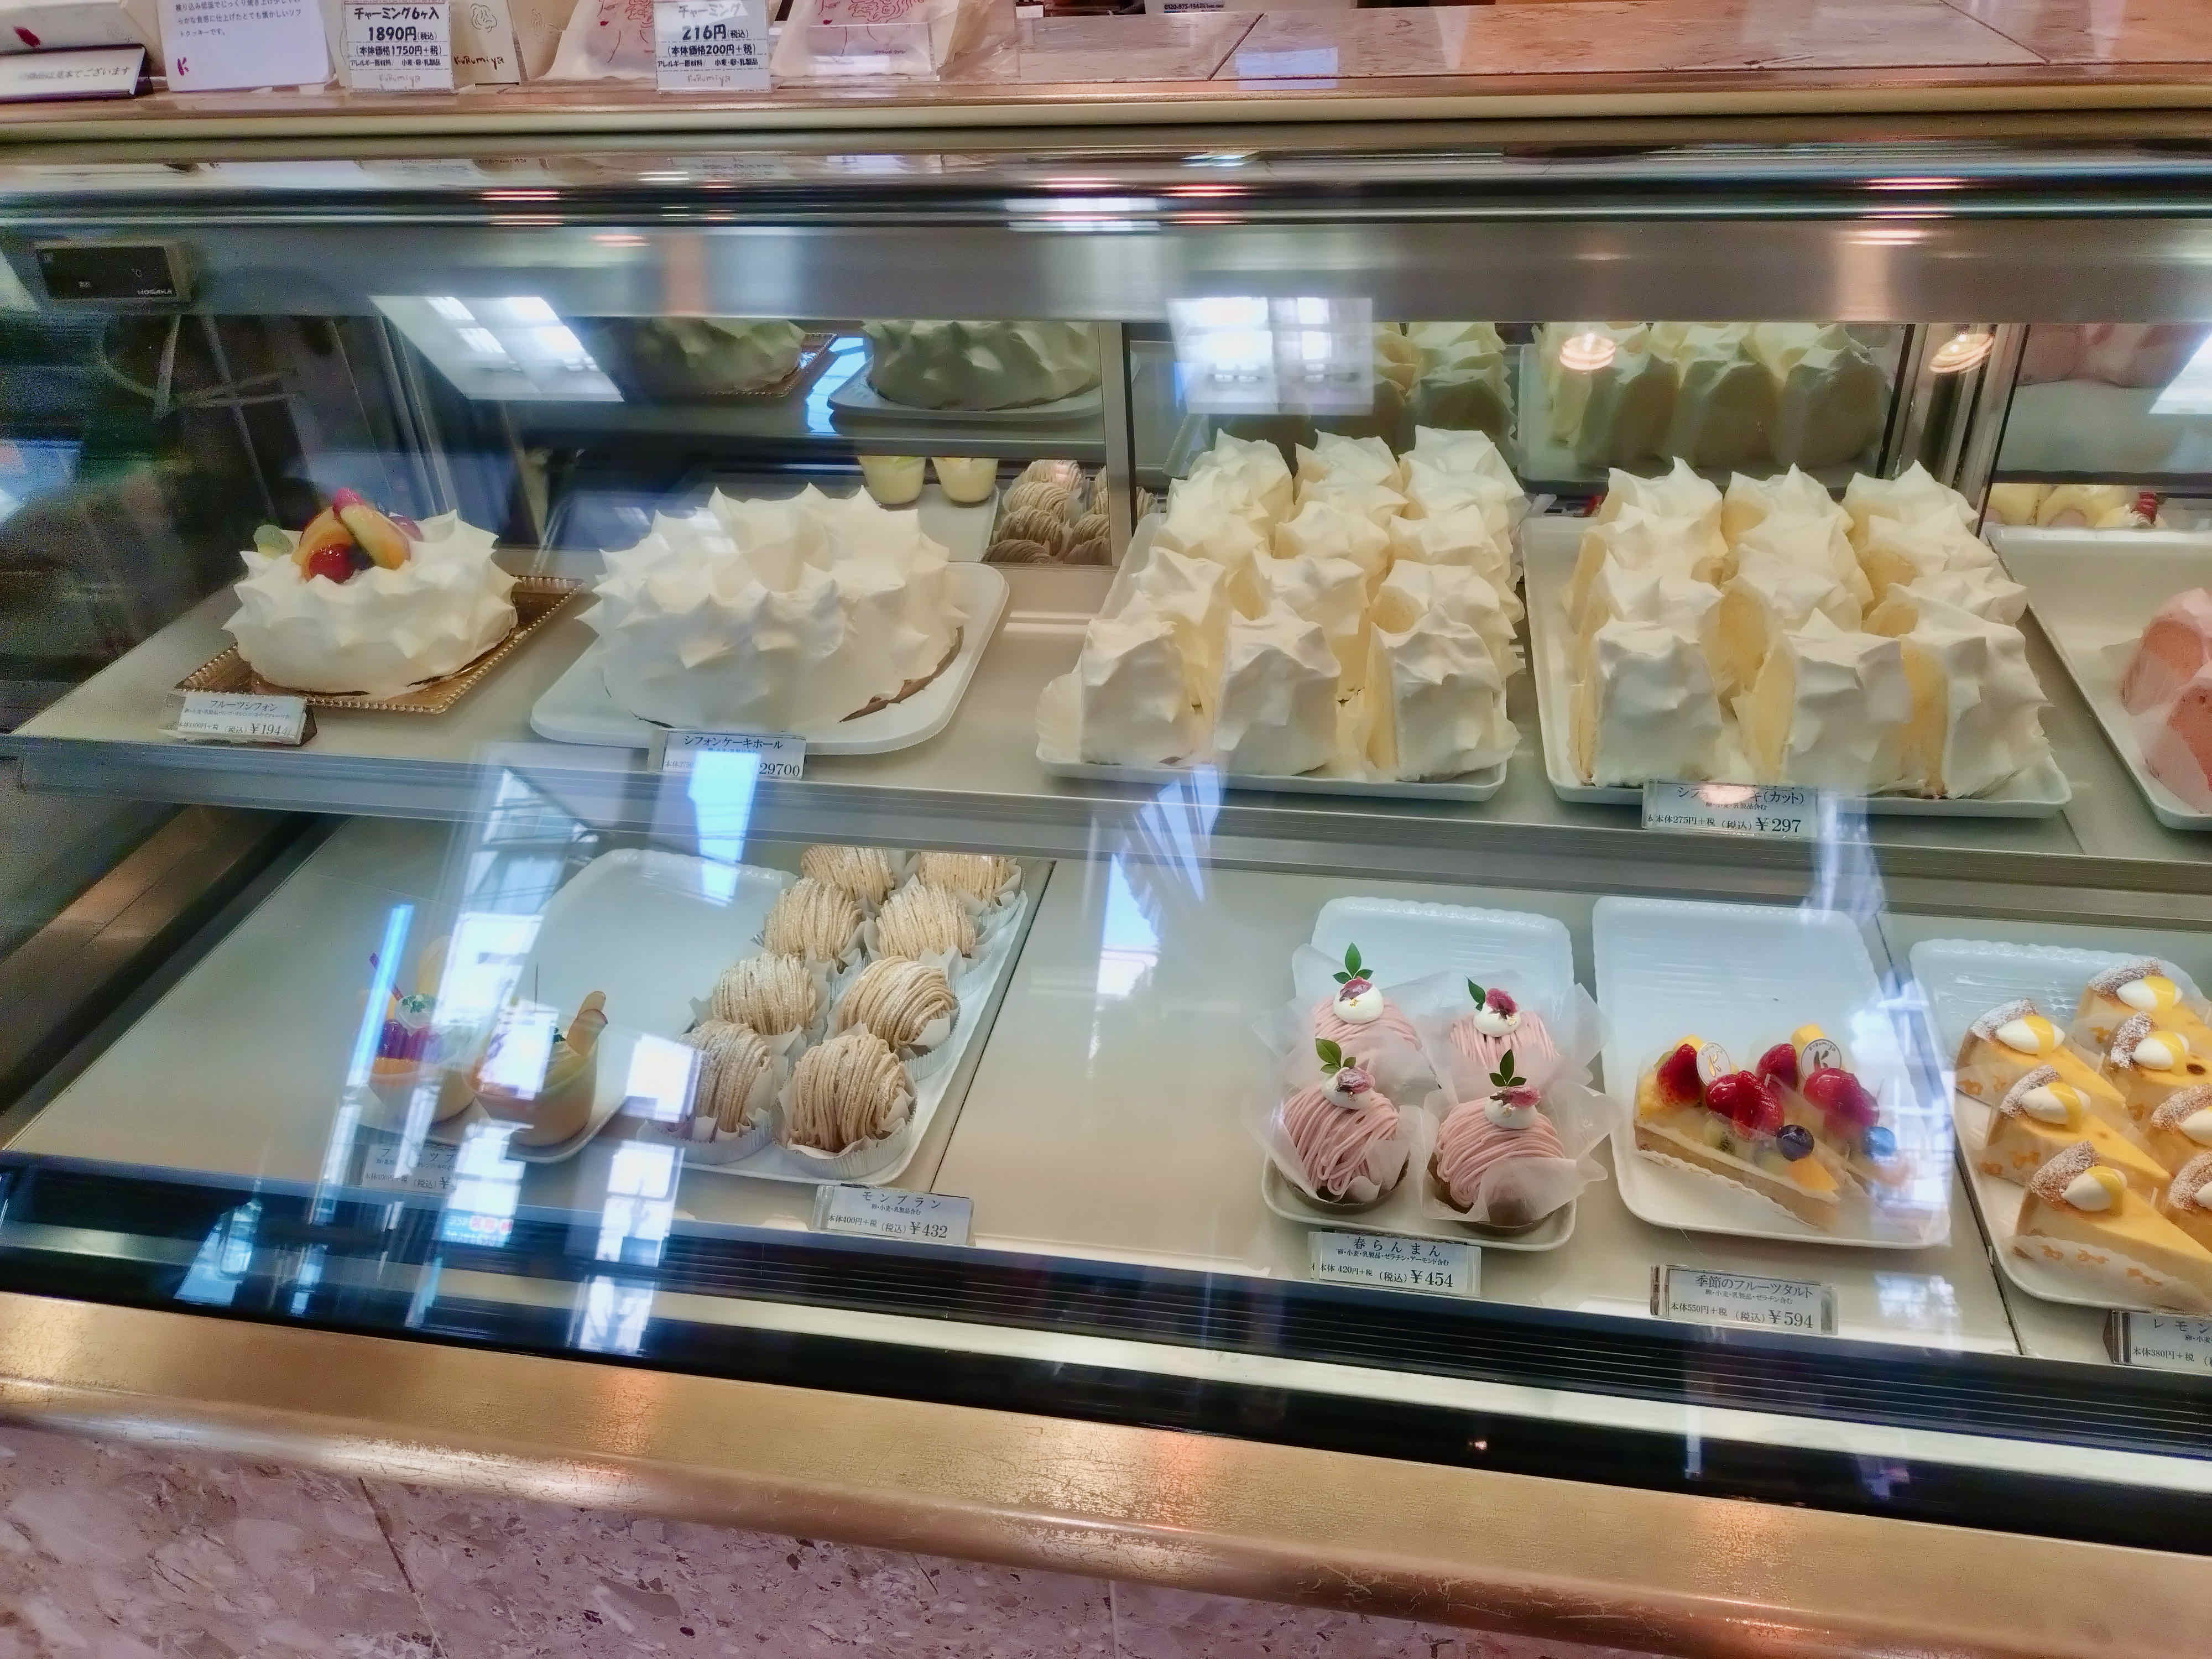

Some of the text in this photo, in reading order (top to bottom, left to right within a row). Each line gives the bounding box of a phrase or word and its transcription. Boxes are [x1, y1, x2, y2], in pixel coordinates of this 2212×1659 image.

[679, 4, 742, 18] チャーミング
[684, 735, 784, 749] シフォンケーキホール
[1677, 786, 1805, 804] シフキ(カット)
[1756, 817, 1801, 833] ¥297
[863, 1191, 941, 1209] モンブラン
[910, 1221, 948, 1239] ¥432
[1354, 1237, 1441, 1257] 春らんまん
[1411, 1270, 1454, 1288] ¥454
[1695, 1275, 1813, 1298] 季節のフルーツタルト
[1768, 1309, 1813, 1329] ¥594
